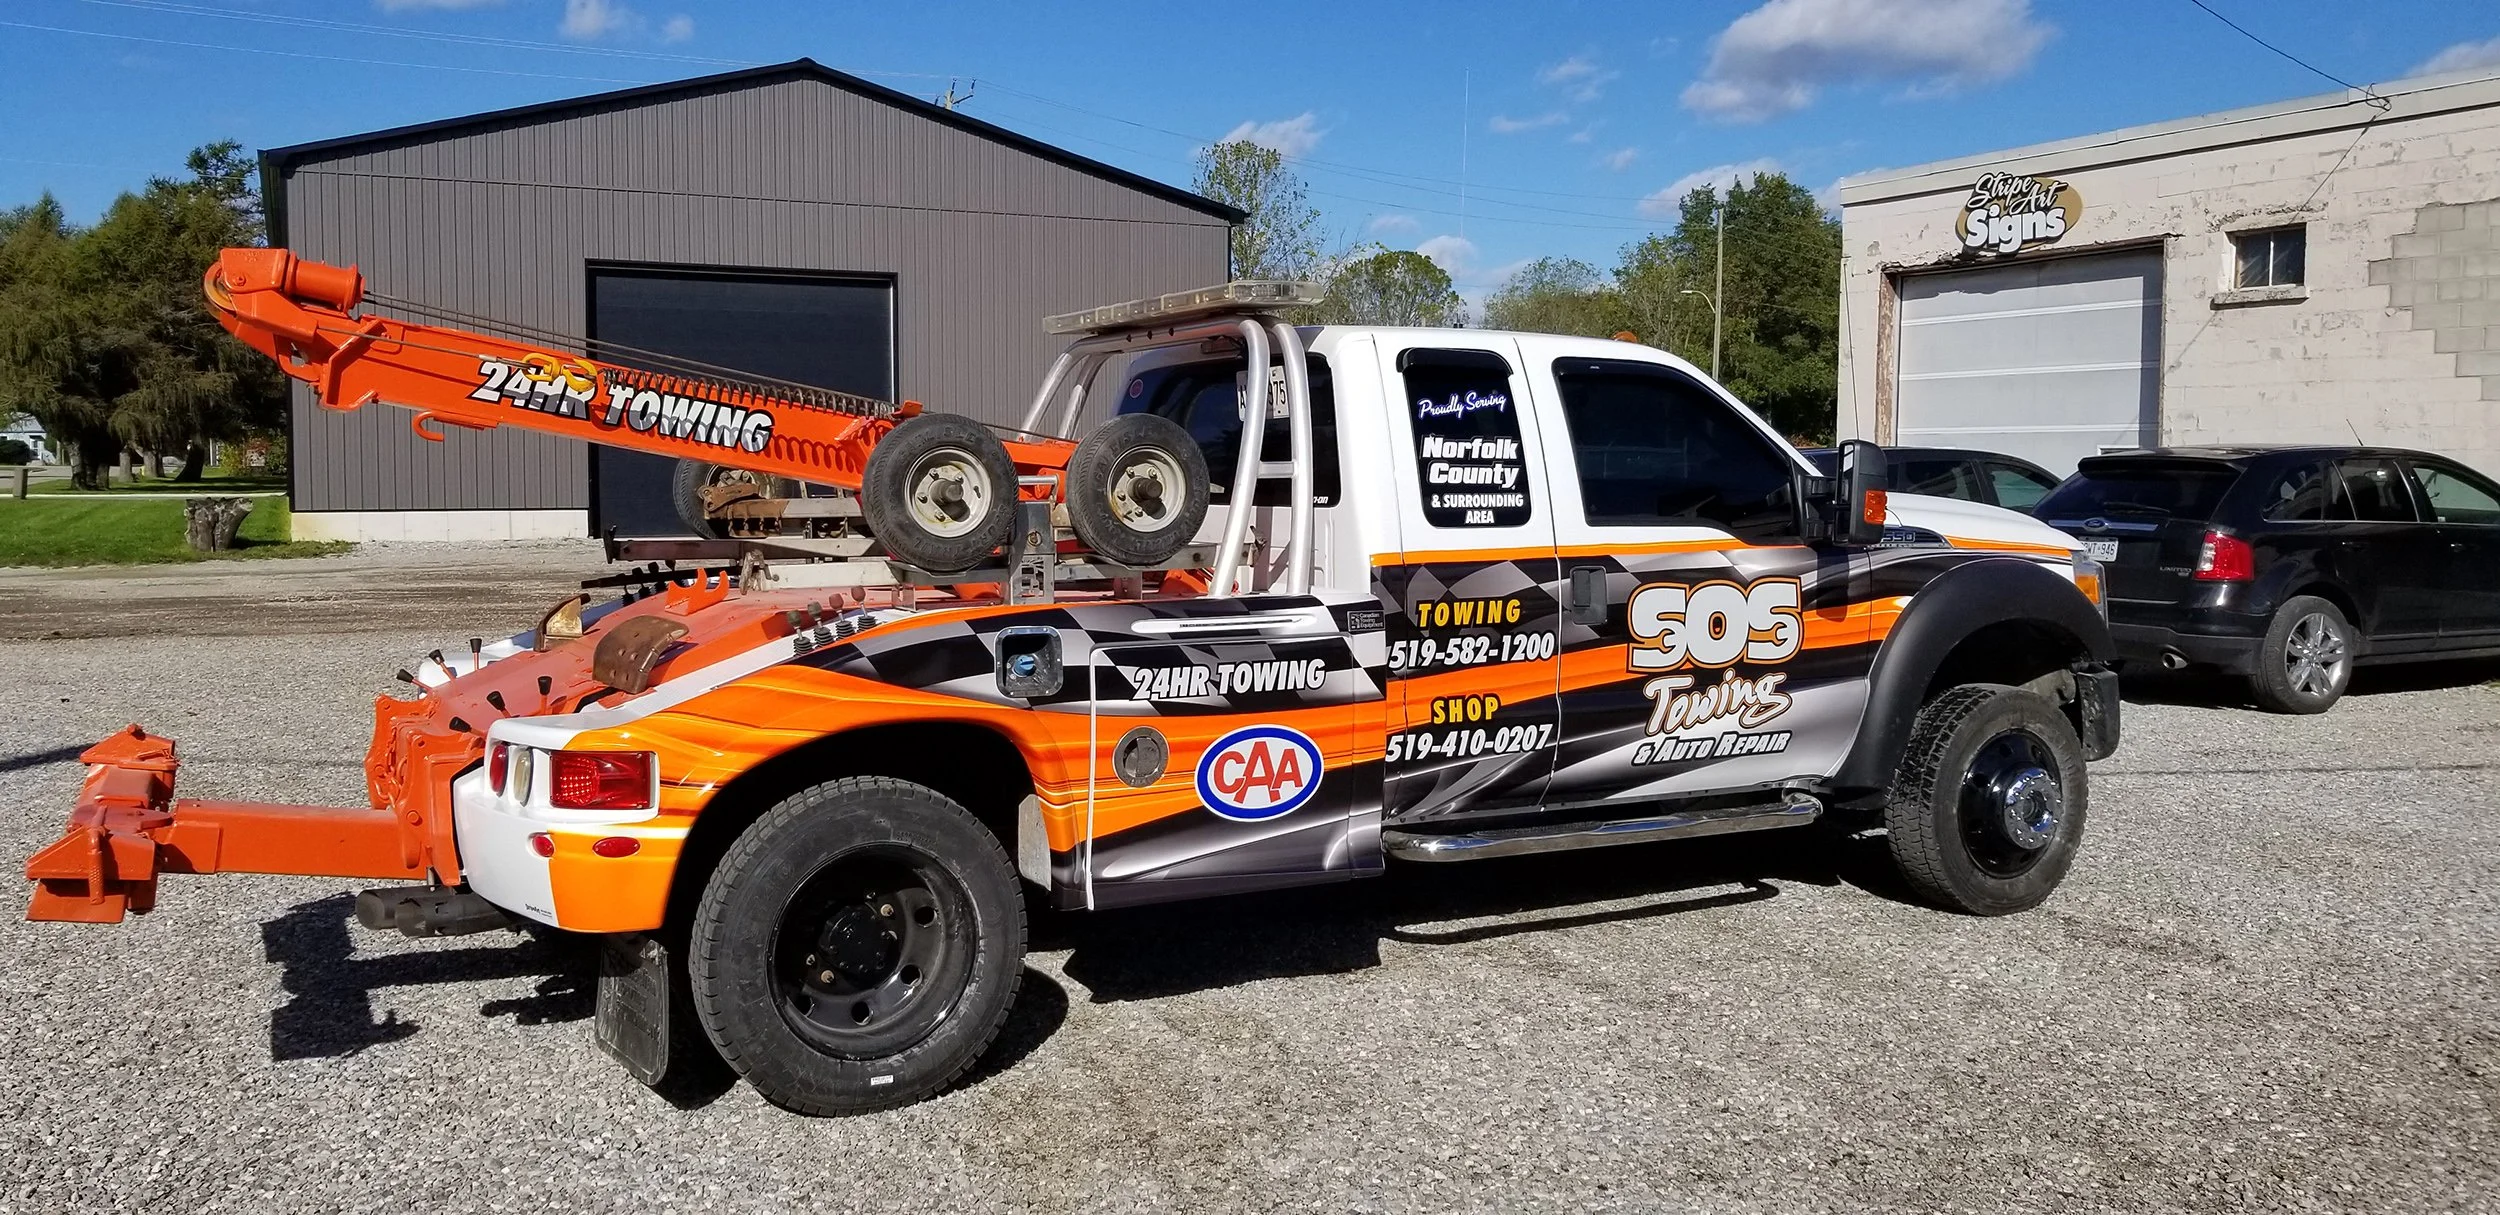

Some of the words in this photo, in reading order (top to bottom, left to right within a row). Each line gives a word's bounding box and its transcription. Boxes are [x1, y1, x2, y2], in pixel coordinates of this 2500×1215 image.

[1967, 173, 2035, 207] Stripe
[2010, 181, 2068, 215] Art
[1965, 204, 2066, 253] Signs
[471, 361, 592, 419] 24HR
[603, 384, 774, 452] TOWING
[1419, 393, 1464, 419] Proudly
[1465, 391, 1507, 412] Serving
[1421, 436, 1519, 460] Norfolk
[1431, 494, 1441, 508] &
[1443, 494, 1524, 508] SURROUNDING
[1466, 511, 1494, 524] AREA
[1418, 599, 1521, 628] TOWING
[1629, 580, 1802, 669] SOS
[1388, 633, 1555, 669] 519-582-1200
[1132, 666, 1209, 700] 24HR
[1218, 659, 1326, 694] TOWING
[1433, 697, 1499, 724] SHOP
[1645, 670, 1791, 735] Towing
[1385, 724, 1553, 762] 519-410-0207
[1633, 744, 1650, 764] &
[1213, 741, 1303, 804] CAA
